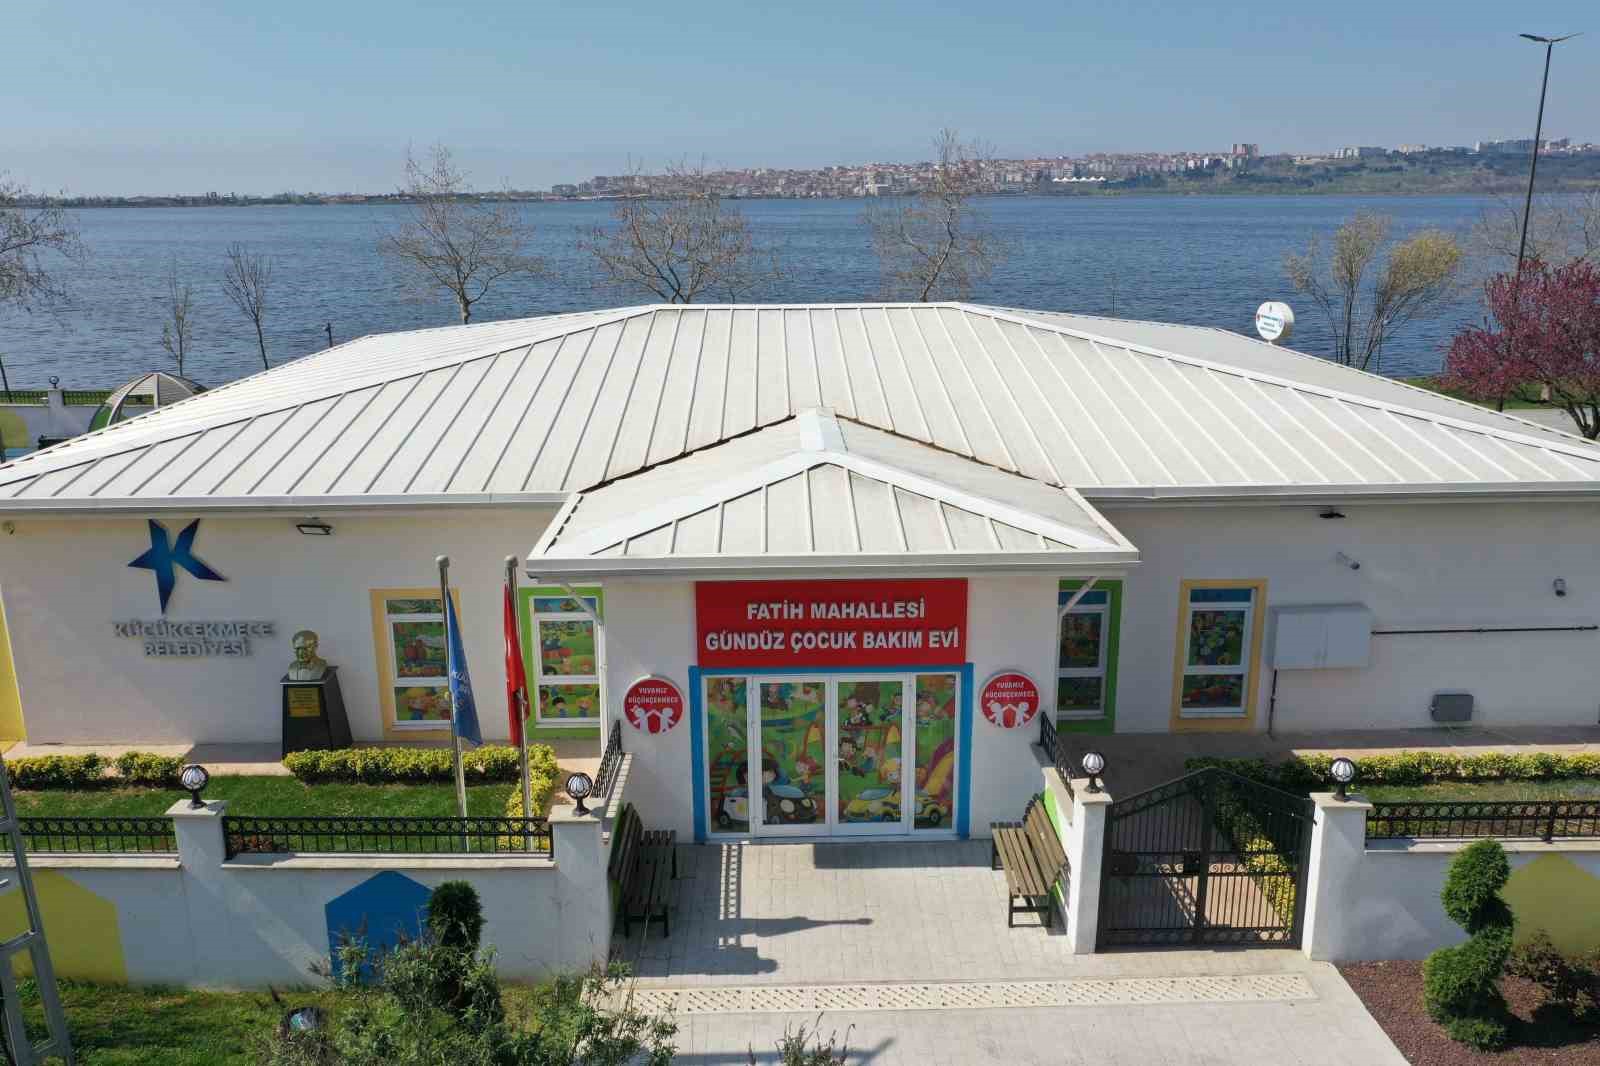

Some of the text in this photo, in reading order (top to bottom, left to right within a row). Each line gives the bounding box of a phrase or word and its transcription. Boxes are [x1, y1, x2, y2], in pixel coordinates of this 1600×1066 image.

[747, 598, 926, 620] FATİH MAHALLESİ
[706, 628, 959, 653] GÜNDÜZ ÇOCUK BAKIM EVİ
